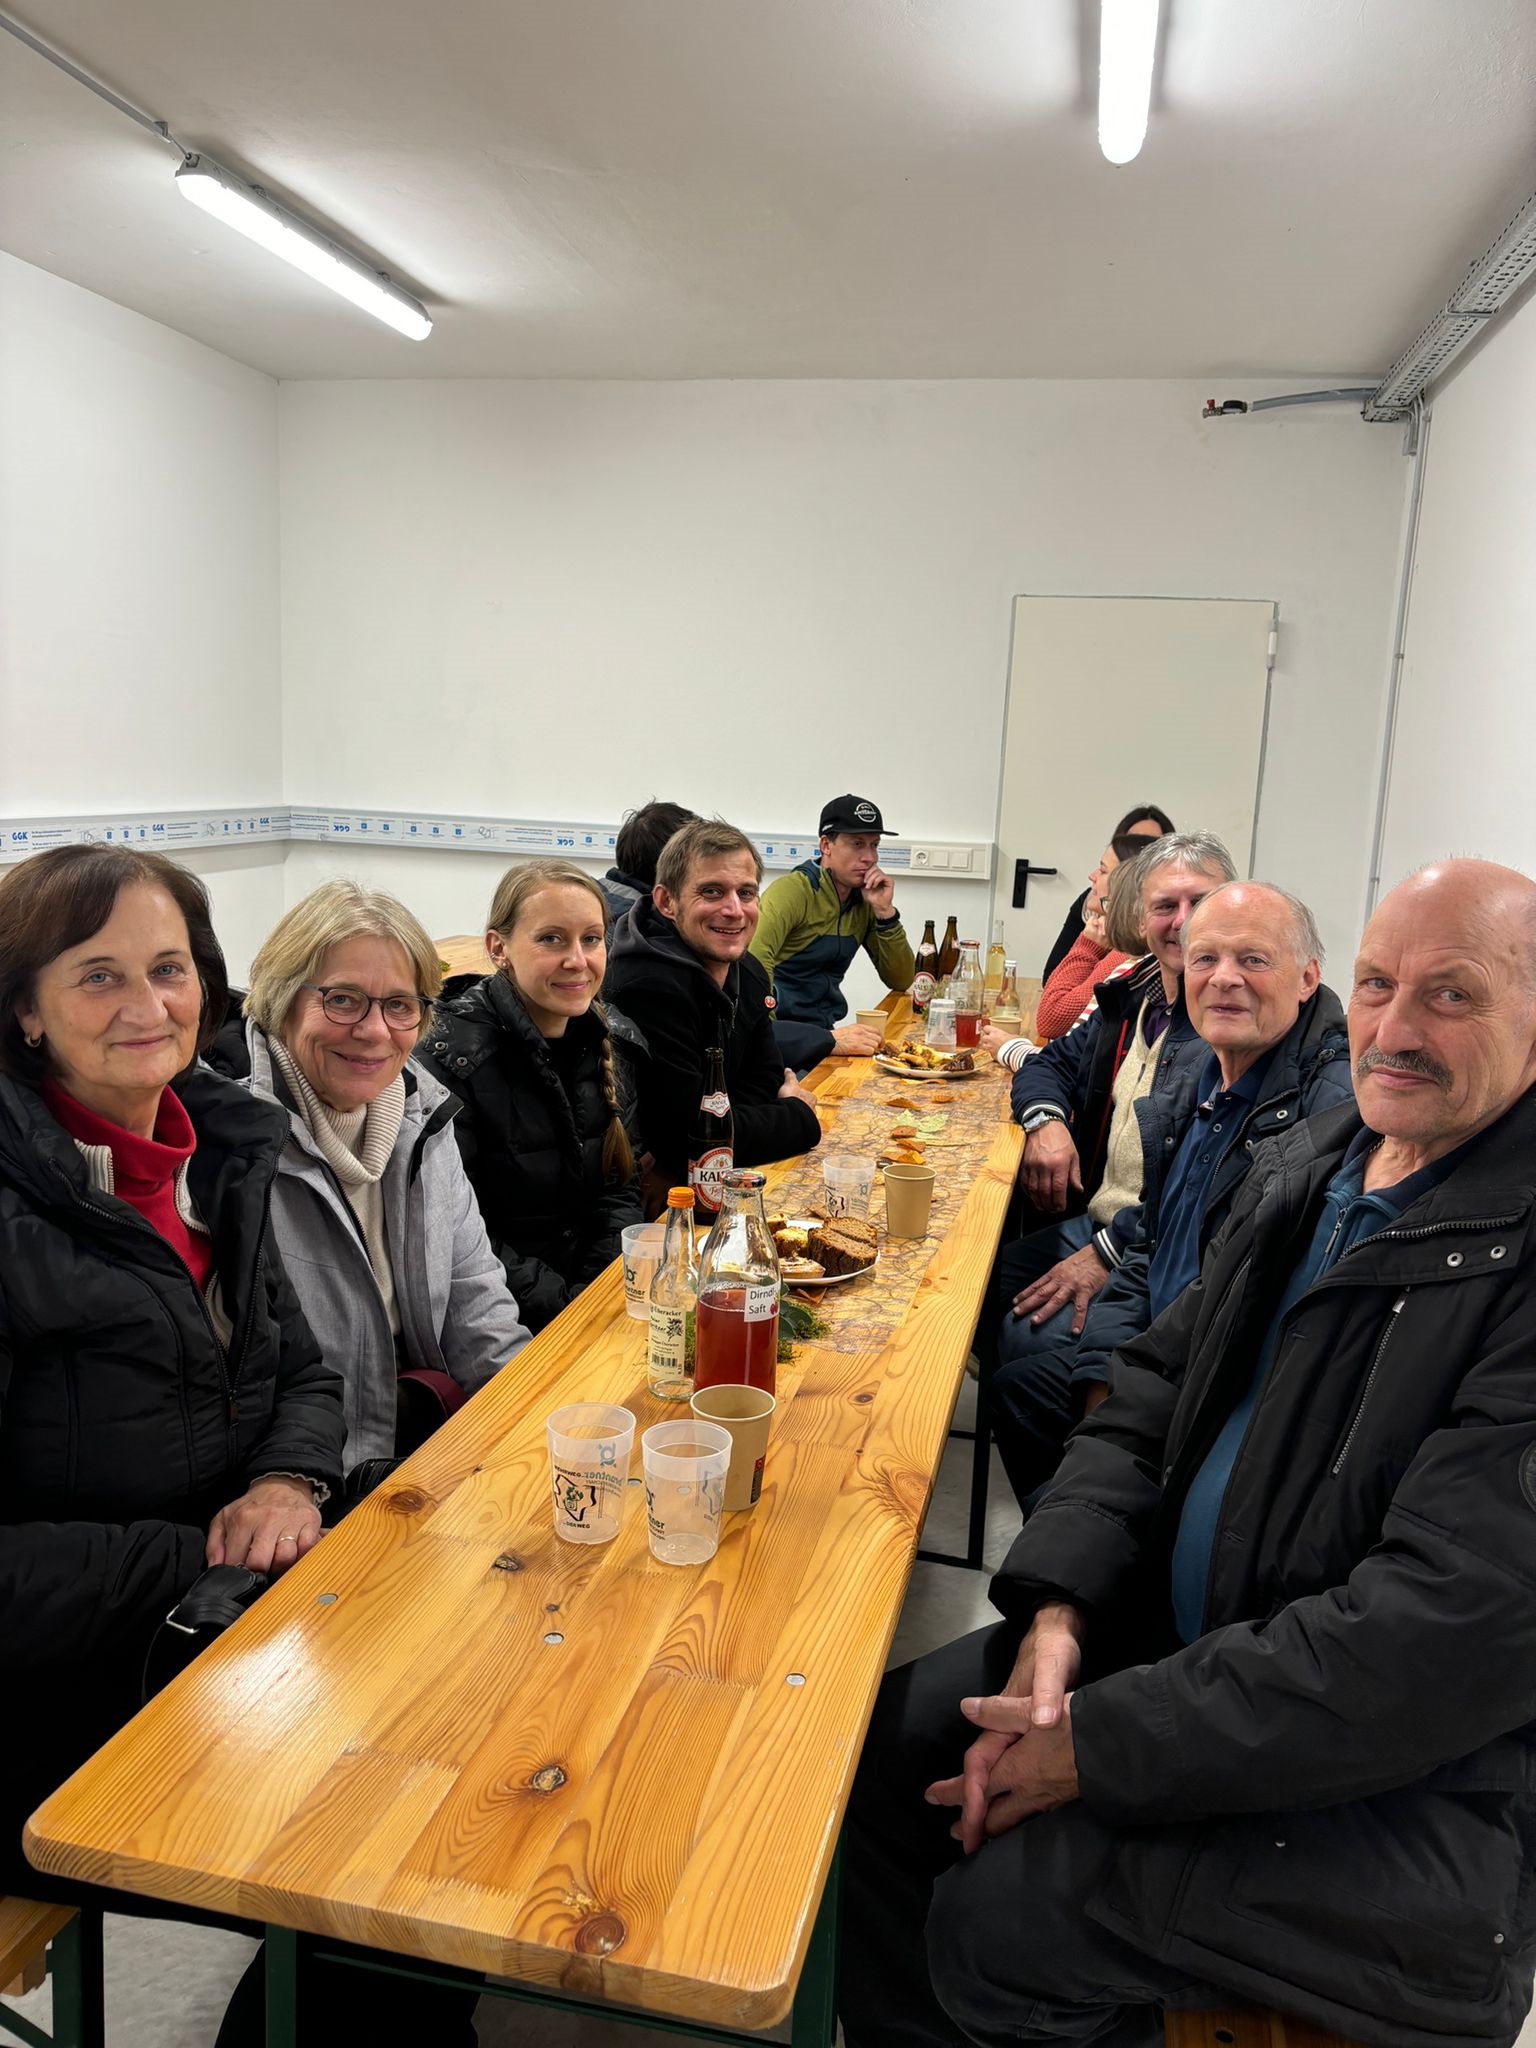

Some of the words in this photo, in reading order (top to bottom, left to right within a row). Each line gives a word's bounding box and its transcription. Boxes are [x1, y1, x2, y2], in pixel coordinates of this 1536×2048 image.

[12, 832, 28, 840] GGK
[557, 838, 574, 846] GGK
[700, 1170, 721, 1182] KAI
[749, 1304, 766, 1314] Saft
